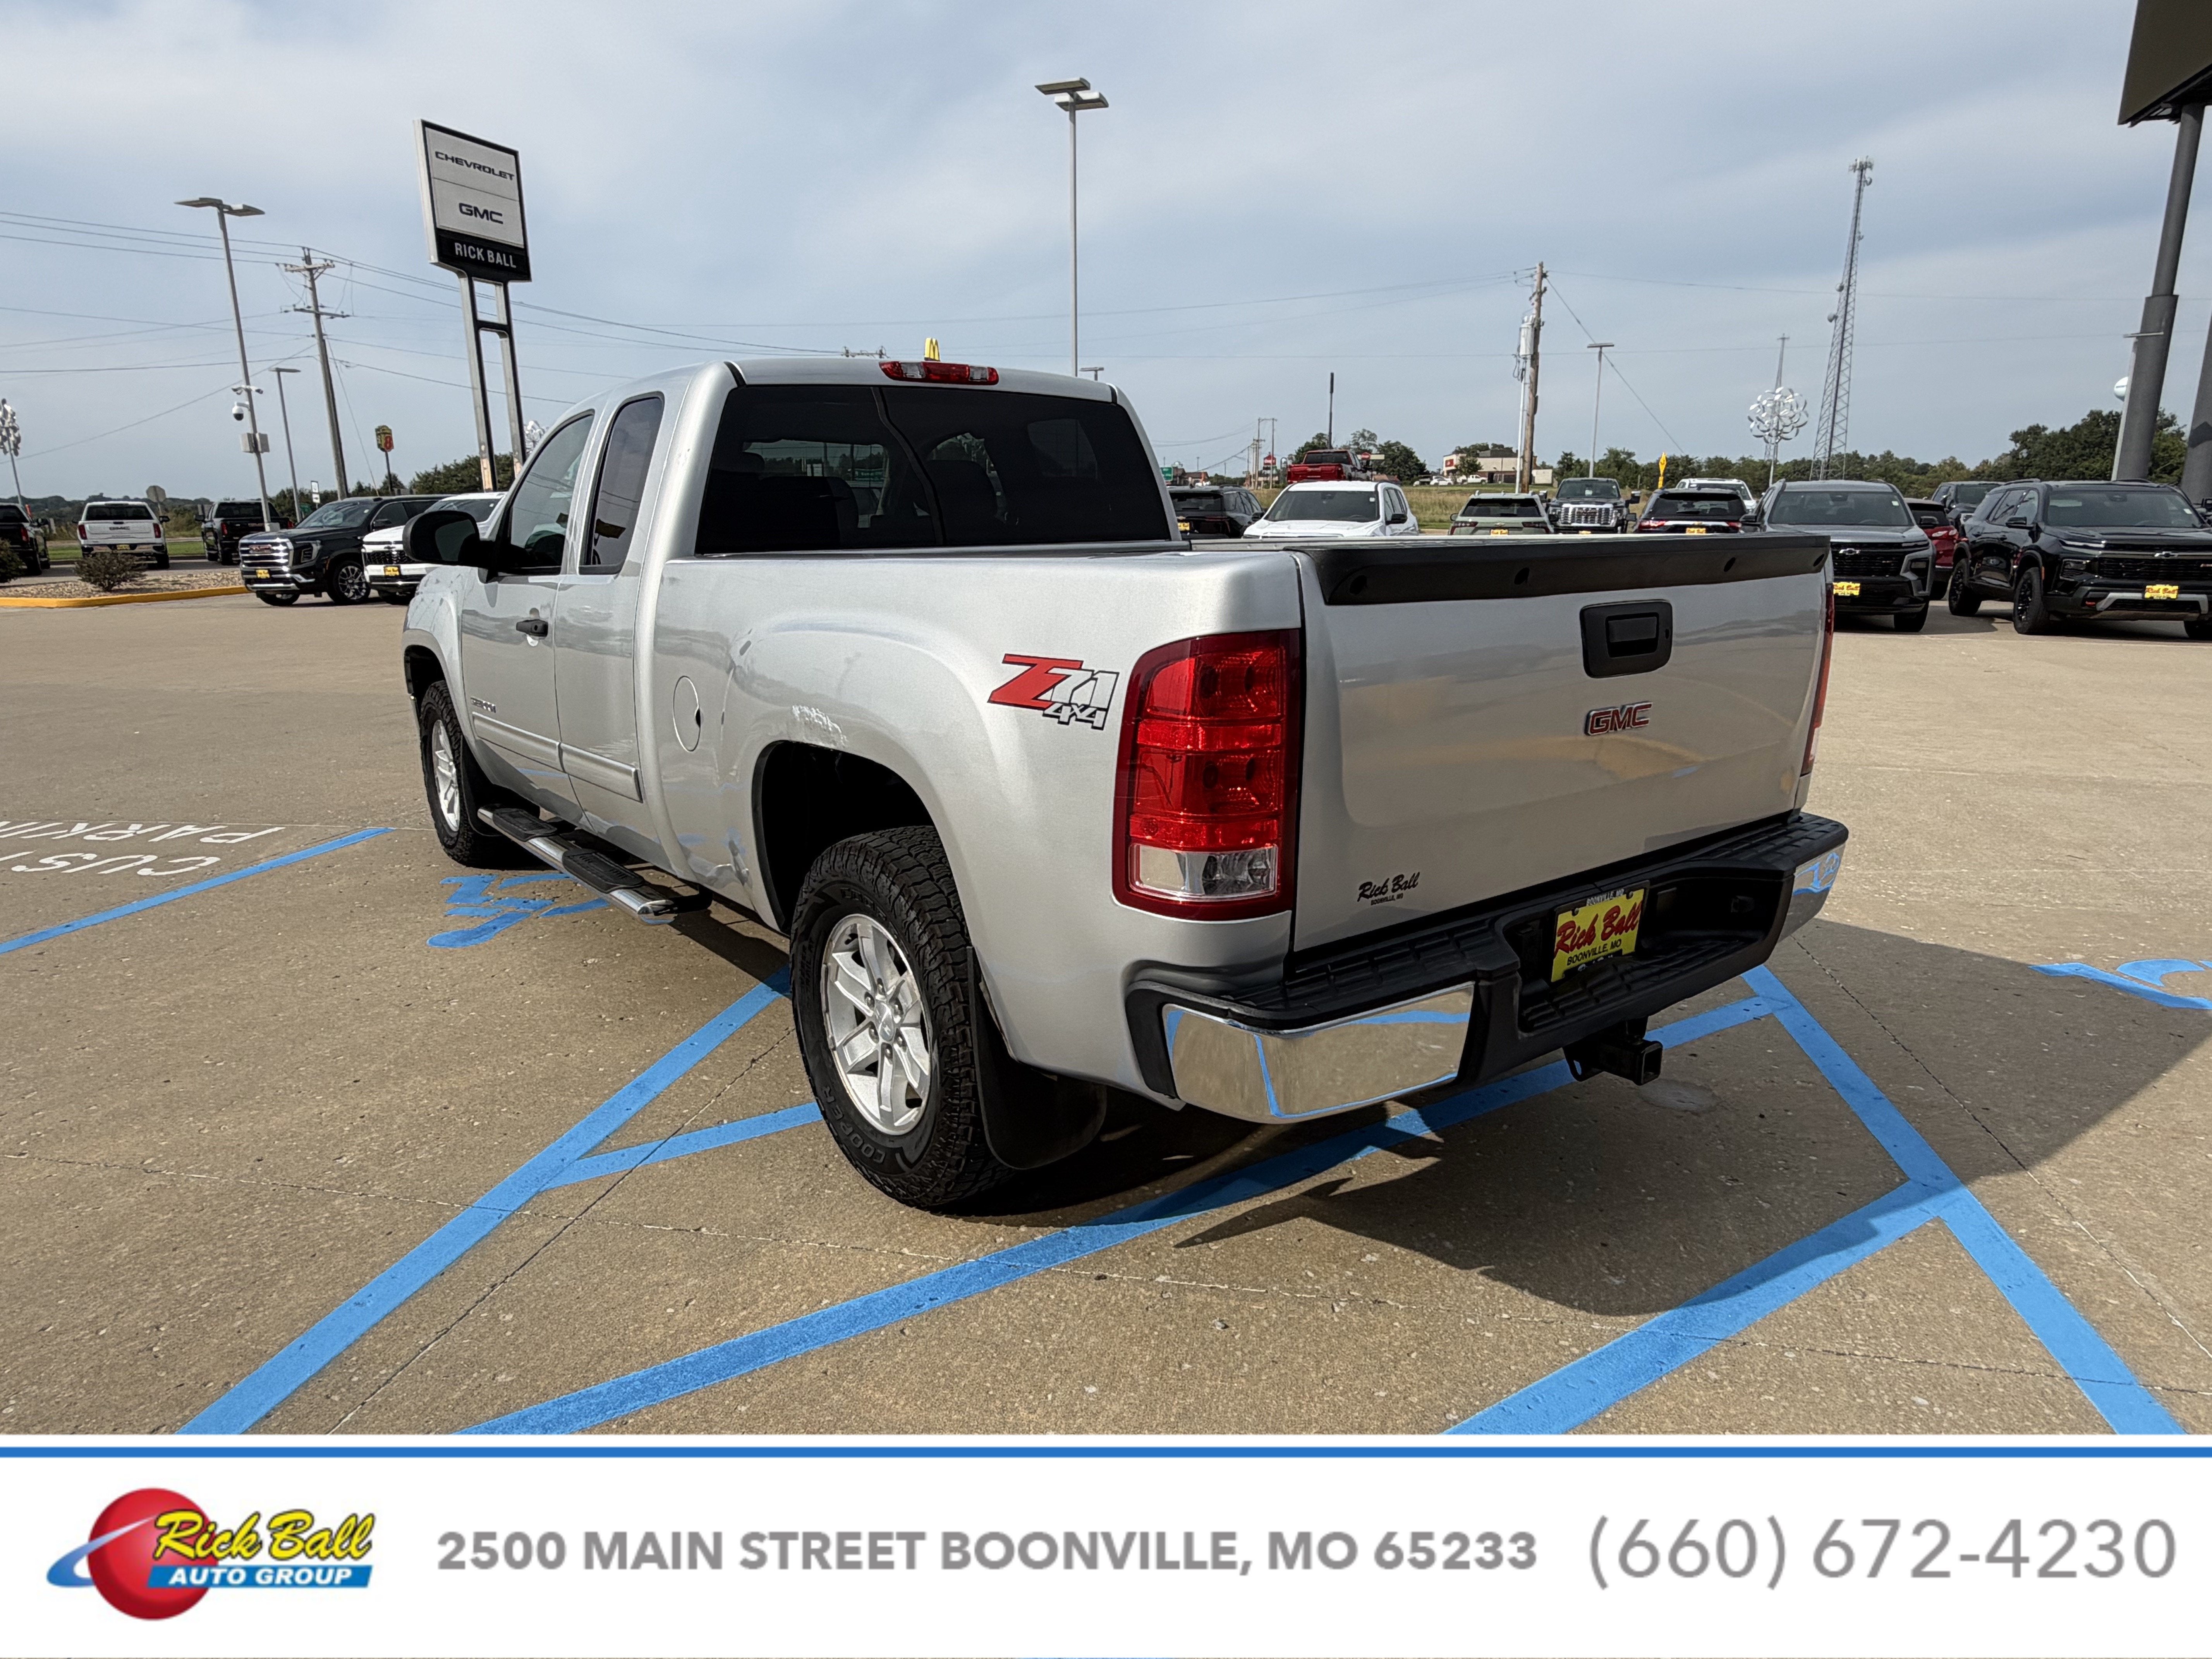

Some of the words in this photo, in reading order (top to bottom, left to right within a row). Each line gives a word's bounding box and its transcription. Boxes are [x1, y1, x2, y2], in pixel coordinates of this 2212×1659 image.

[435, 151, 514, 180] CHEVROLET
[459, 203, 503, 224] GMC
[455, 242, 485, 261] RICK
[487, 251, 517, 268] BALL
[987, 653, 1120, 711] Z71
[1585, 701, 1653, 735] GMC
[1357, 878, 1390, 902] Rick
[1391, 872, 1420, 893] Ball
[1554, 913, 1599, 957] Rick
[1601, 901, 1642, 941] Ball
[822, 1085, 886, 1164] COOPER
